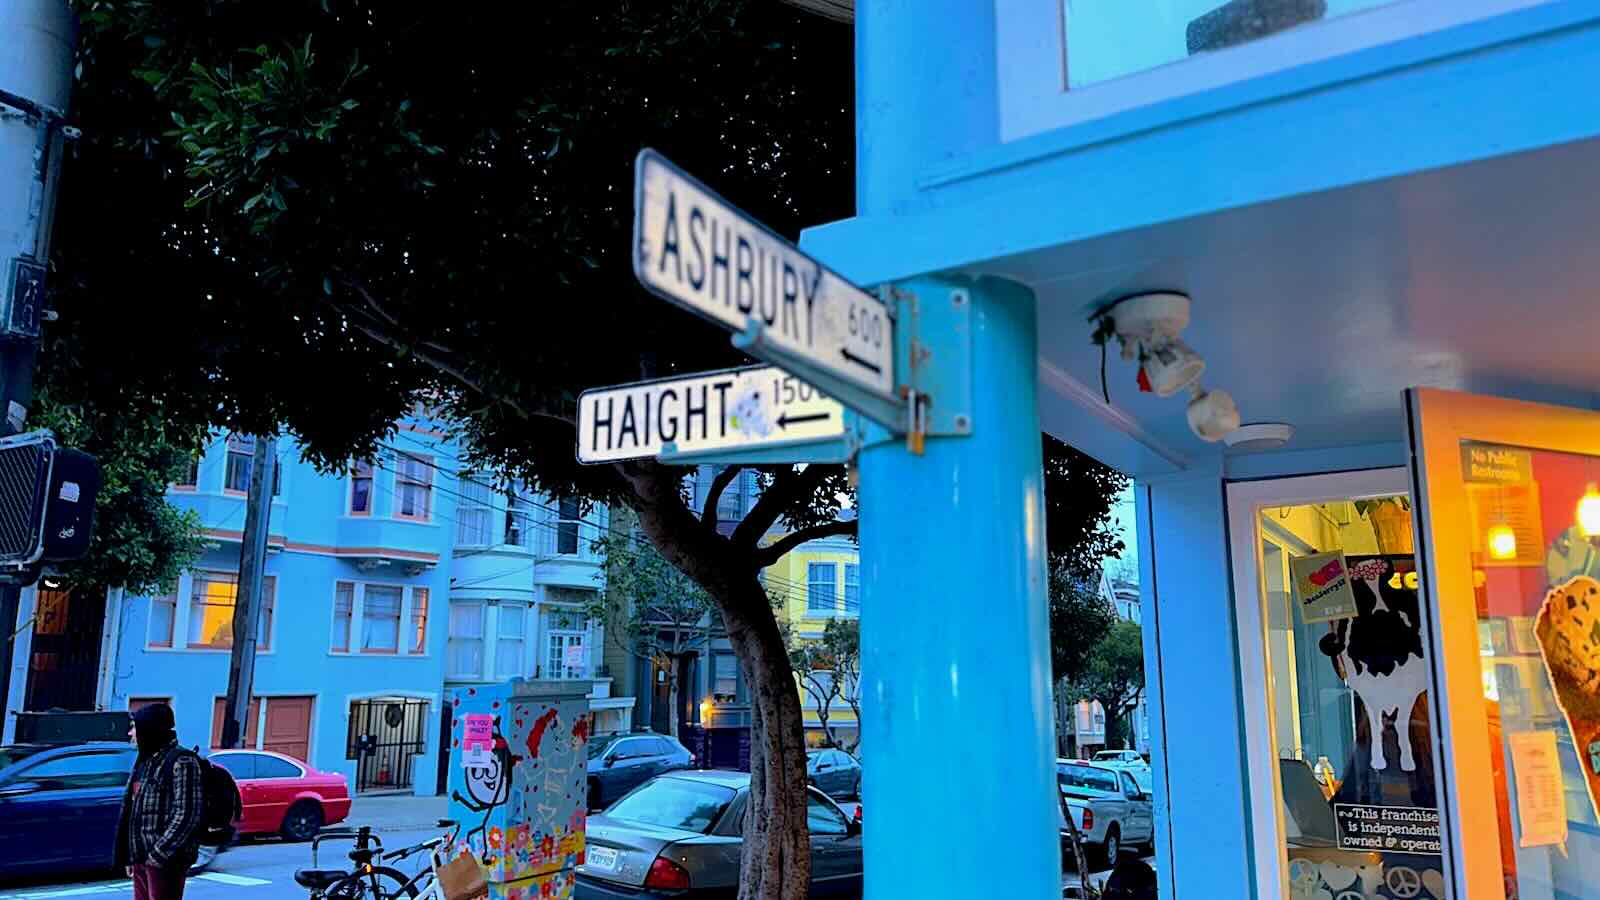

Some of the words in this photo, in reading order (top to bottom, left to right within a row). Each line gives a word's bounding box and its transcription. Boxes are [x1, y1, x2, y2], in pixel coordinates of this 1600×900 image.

[660, 190, 822, 347] ASHBURY
[848, 301, 882, 350] 600
[593, 383, 732, 451] HAIGHT
[1348, 821, 1358, 832] is
[1353, 808, 1378, 819] This
[1381, 809, 1440, 822] franchise
[1343, 836, 1382, 848] owned
